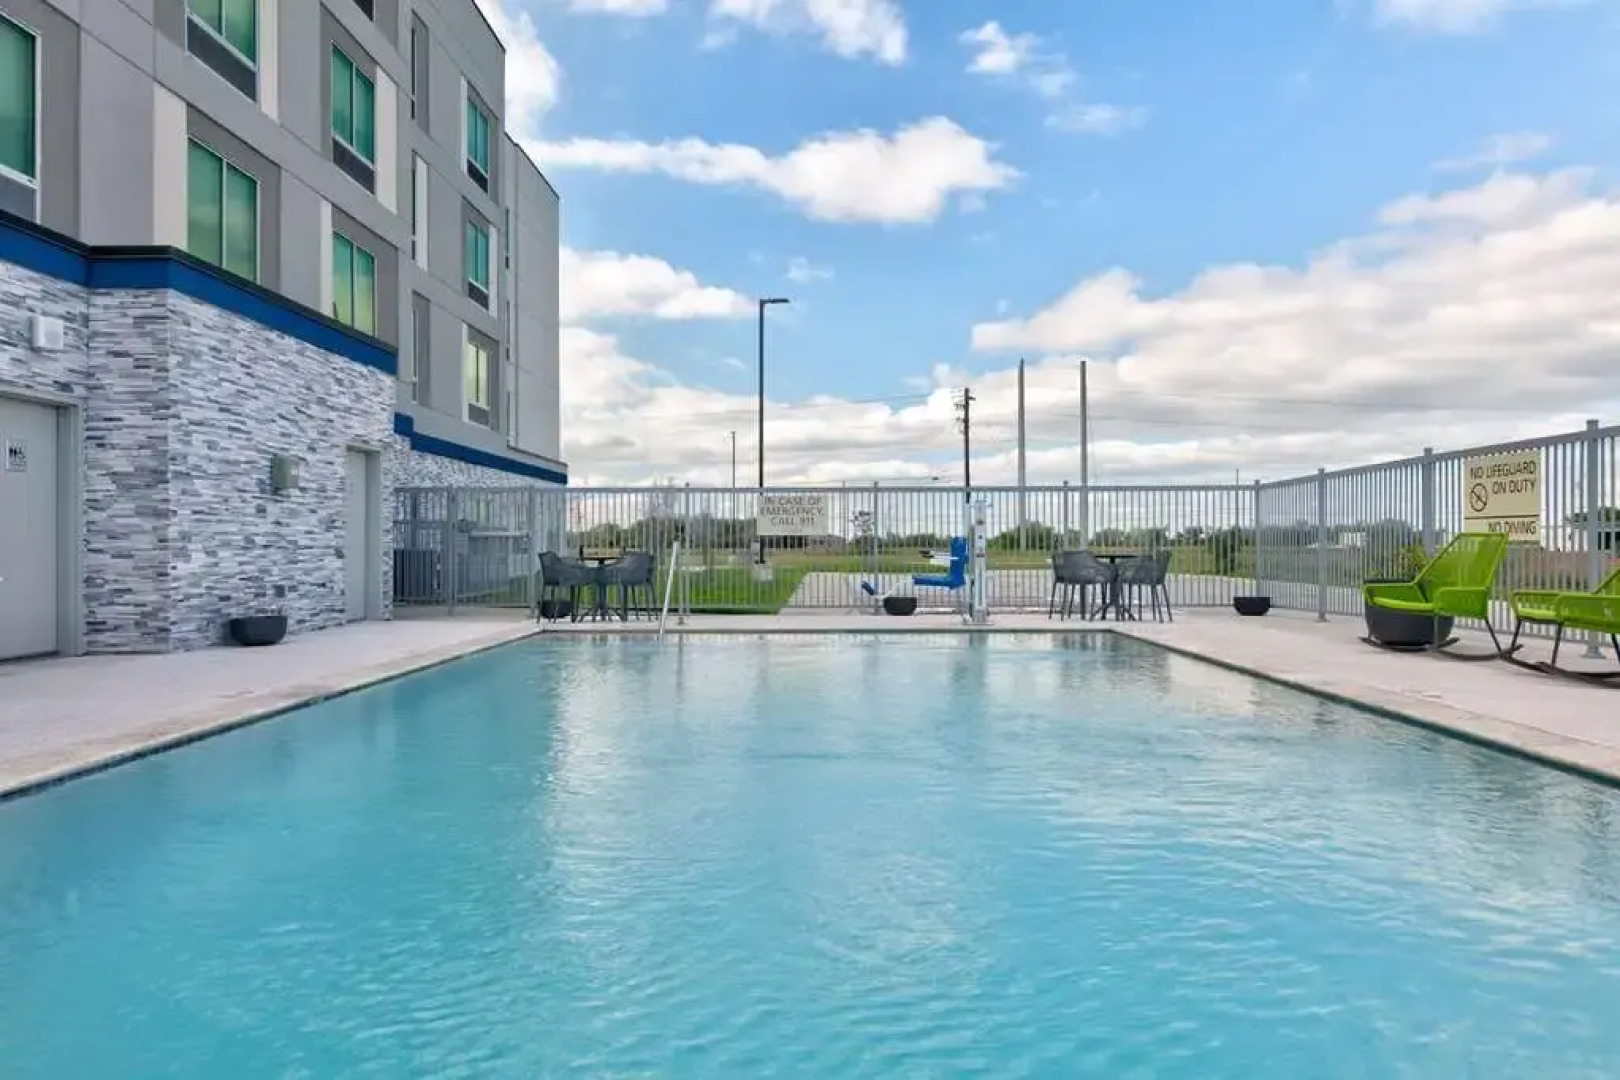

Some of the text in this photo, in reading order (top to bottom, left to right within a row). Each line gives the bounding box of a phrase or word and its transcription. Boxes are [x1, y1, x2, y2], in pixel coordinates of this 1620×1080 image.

[1470, 460, 1536, 480] NO LIFEGUARD
[1492, 479, 1536, 494] ON DUTY
[764, 496, 821, 506] IN CASE OF
[799, 517, 815, 526] 911
[1488, 520, 1536, 534] NO DIVING
